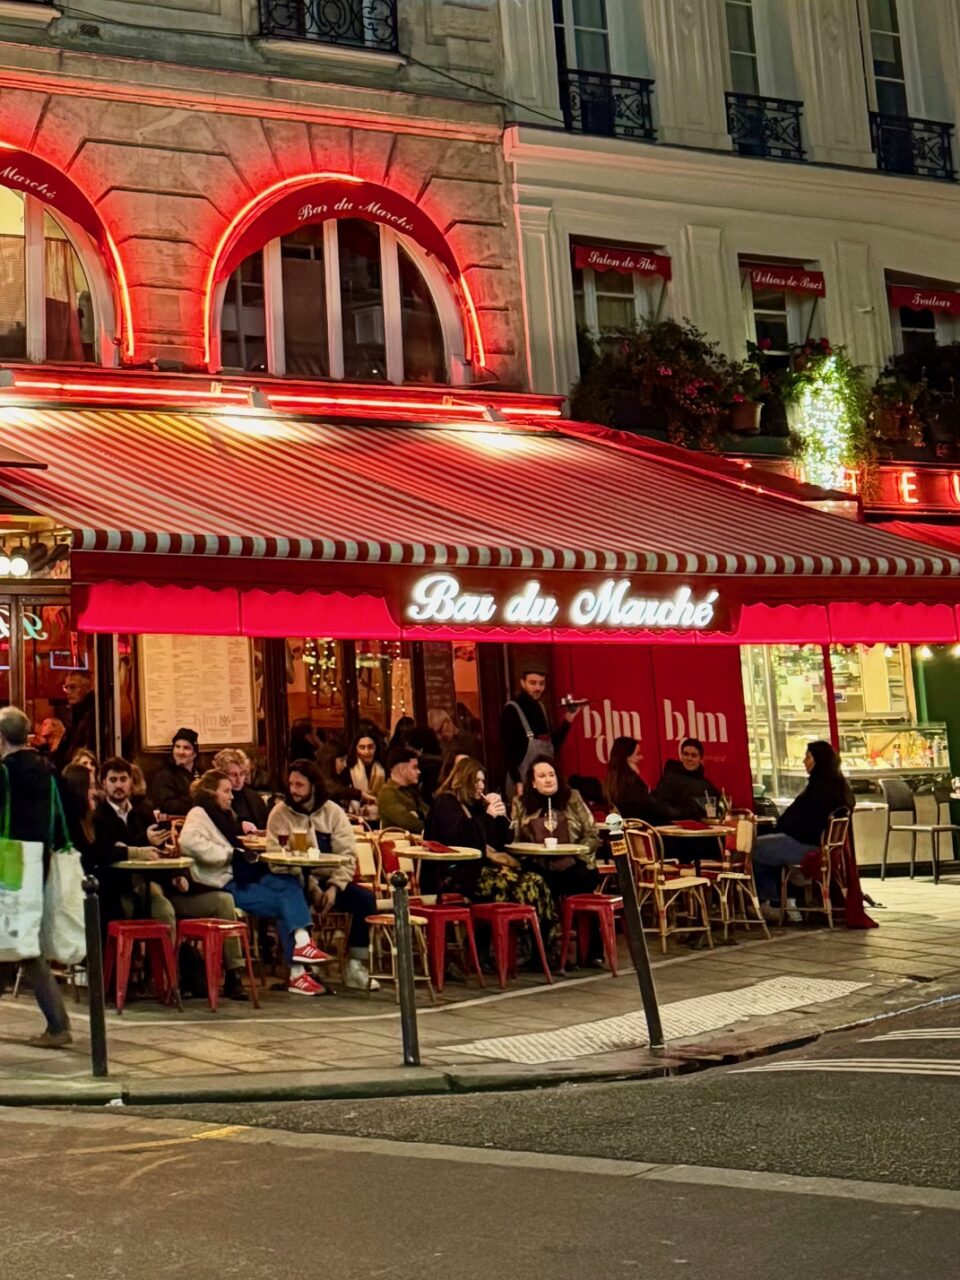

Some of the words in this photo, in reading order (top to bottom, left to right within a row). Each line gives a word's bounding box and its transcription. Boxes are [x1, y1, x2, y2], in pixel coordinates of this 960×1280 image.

[298, 204, 328, 221] Bar
[334, 197, 354, 211] du
[358, 201, 414, 232] Marché
[587, 250, 620, 267] Salon
[621, 256, 635, 269] de
[636, 257, 657, 271] Thé
[786, 275, 798, 287] de
[407, 573, 497, 621] Bar
[503, 579, 559, 623] du
[569, 577, 720, 628] Marché
